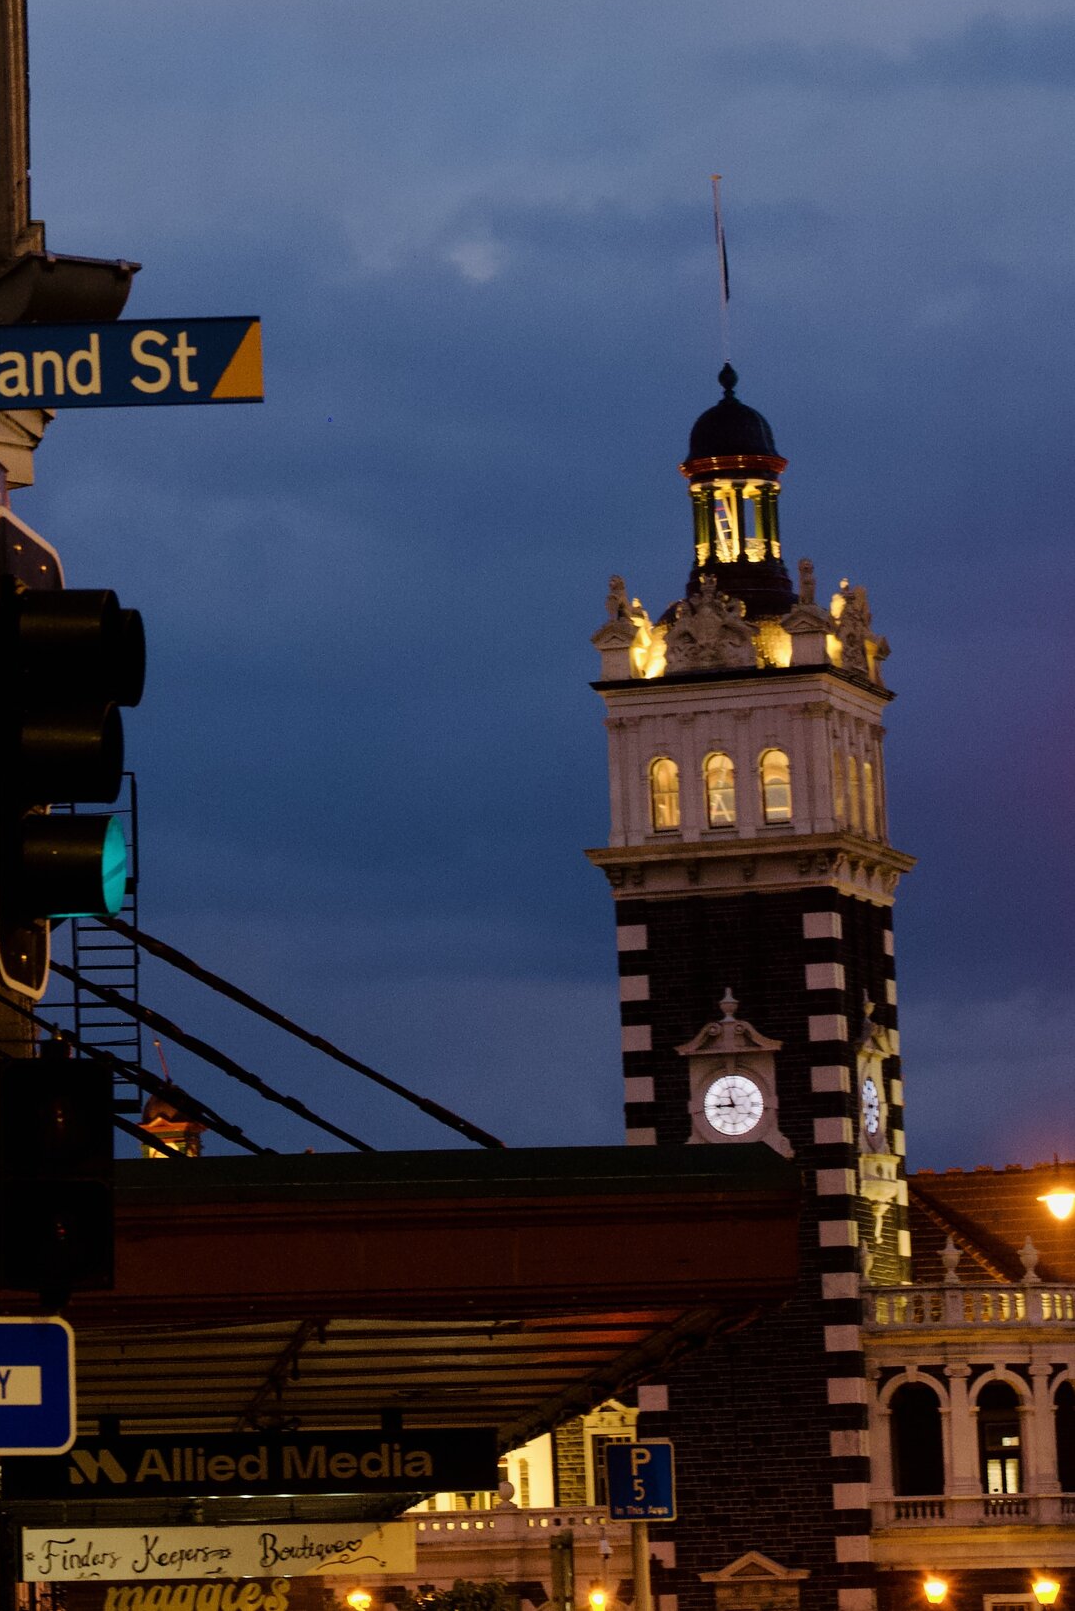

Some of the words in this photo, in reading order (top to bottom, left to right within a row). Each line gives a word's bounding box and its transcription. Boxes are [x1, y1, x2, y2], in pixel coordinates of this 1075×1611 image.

[130, 329, 199, 393] St
[134, 1446, 268, 1483] Allied
[281, 1443, 434, 1480] Media
[630, 1447, 653, 1477] P
[632, 1478, 646, 1502] 5
[38, 1537, 122, 1575] Finders
[131, 1534, 212, 1574] Keepers
[258, 1532, 347, 1568] Boutique
